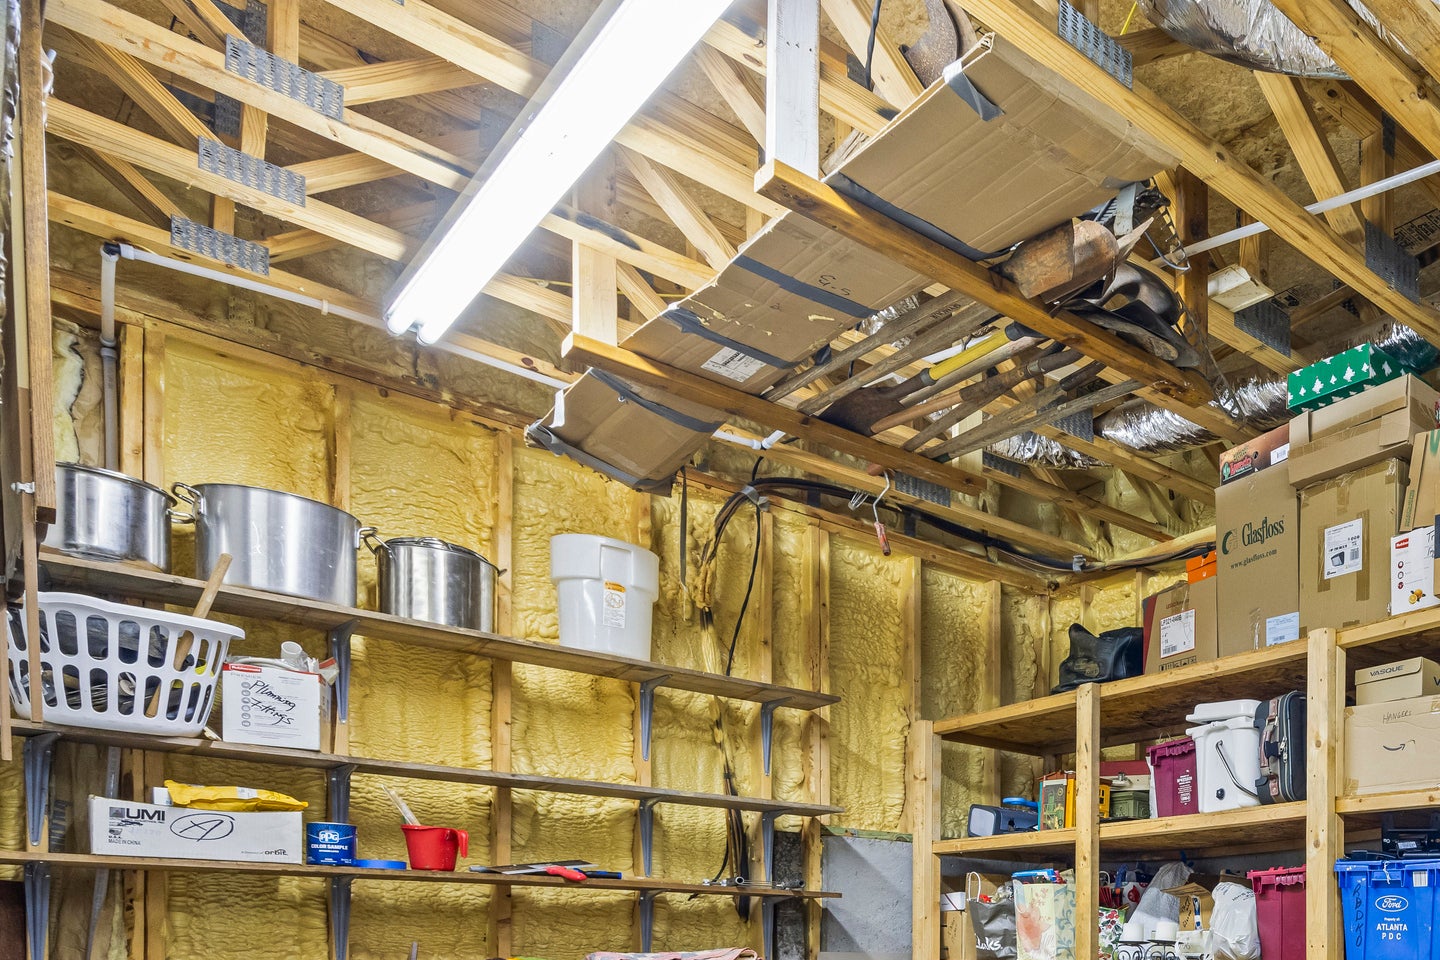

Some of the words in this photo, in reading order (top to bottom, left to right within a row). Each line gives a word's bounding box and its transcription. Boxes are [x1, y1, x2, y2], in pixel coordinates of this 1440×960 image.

[1241, 516, 1285, 547] Glasfloss
[1369, 665, 1404, 677] VASQUE
[126, 807, 166, 821] UMI
[320, 831, 339, 843] PPG
[1381, 898, 1402, 909] Ford
[1376, 923, 1408, 931] ATLANTA
